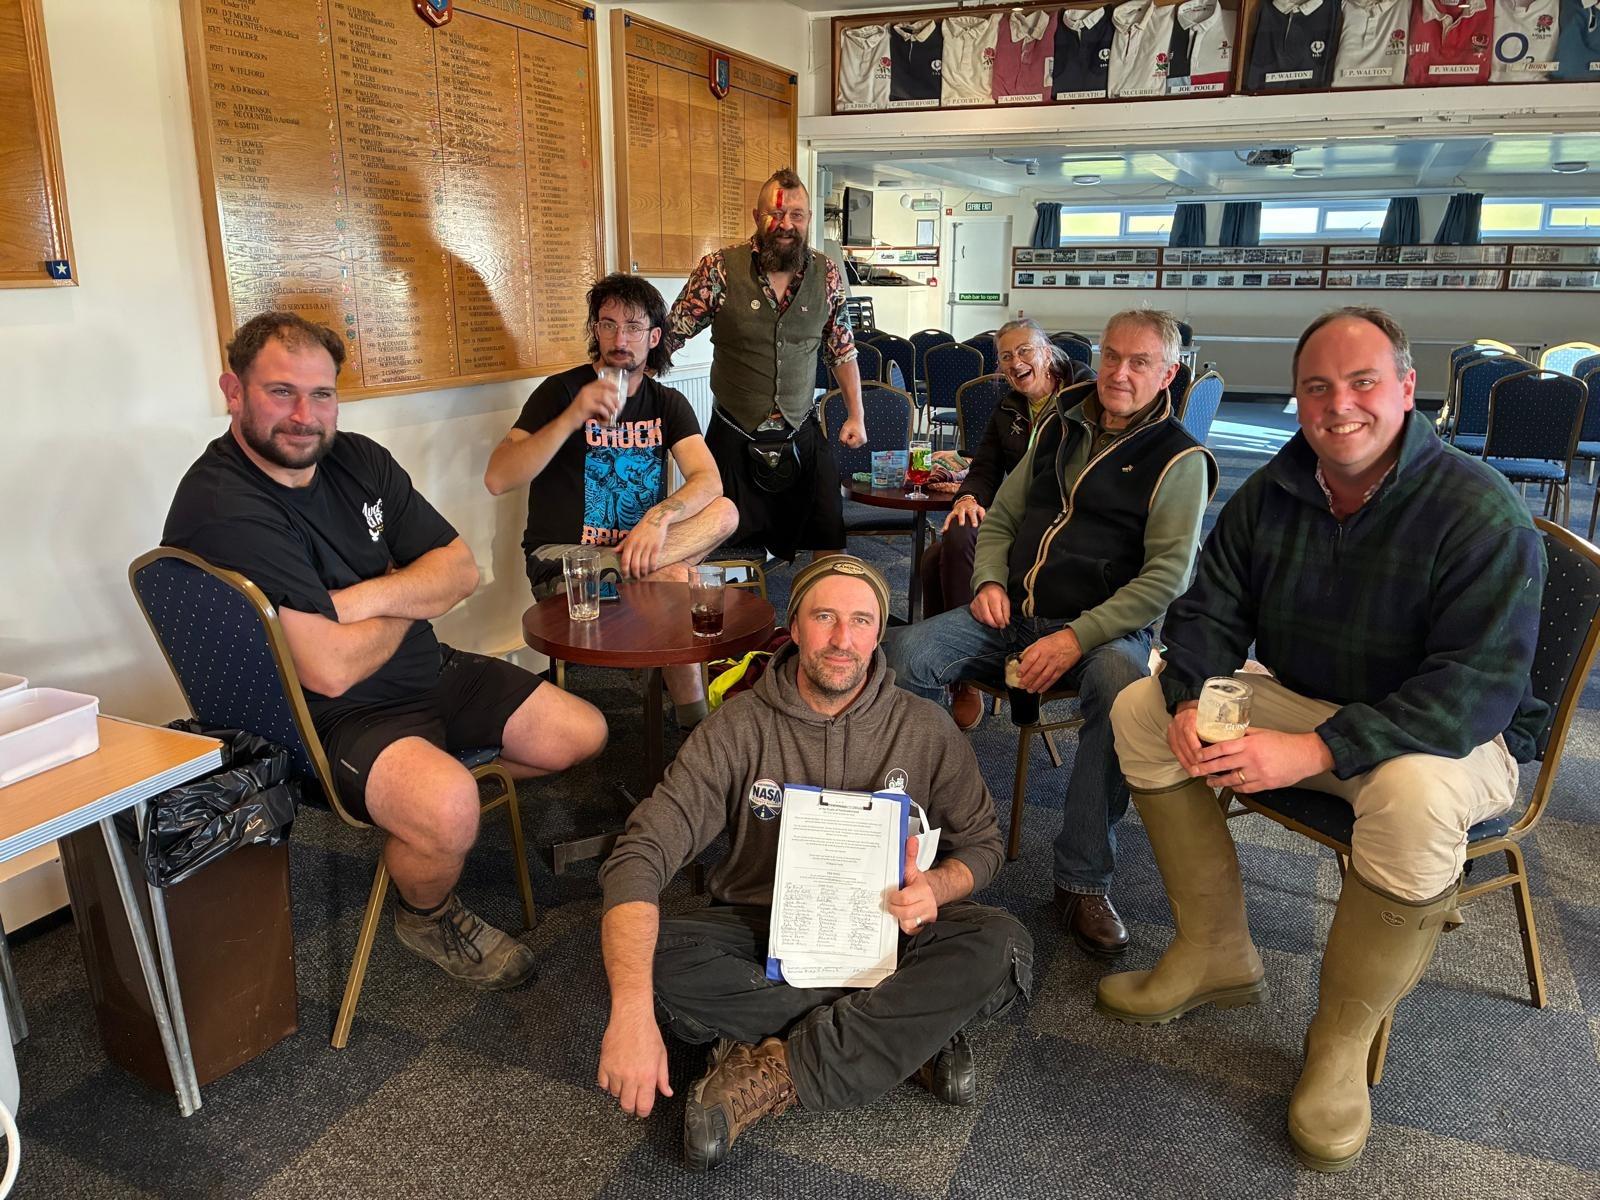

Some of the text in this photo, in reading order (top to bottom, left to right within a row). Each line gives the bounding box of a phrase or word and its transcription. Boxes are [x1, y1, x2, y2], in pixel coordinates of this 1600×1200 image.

[1278, 72, 1309, 80] WALTON
[1178, 84, 1217, 93] JOE POOLE
[972, 203, 981, 211] FIRE
[585, 418, 663, 449] CHUCK
[752, 785, 781, 803] NASA
